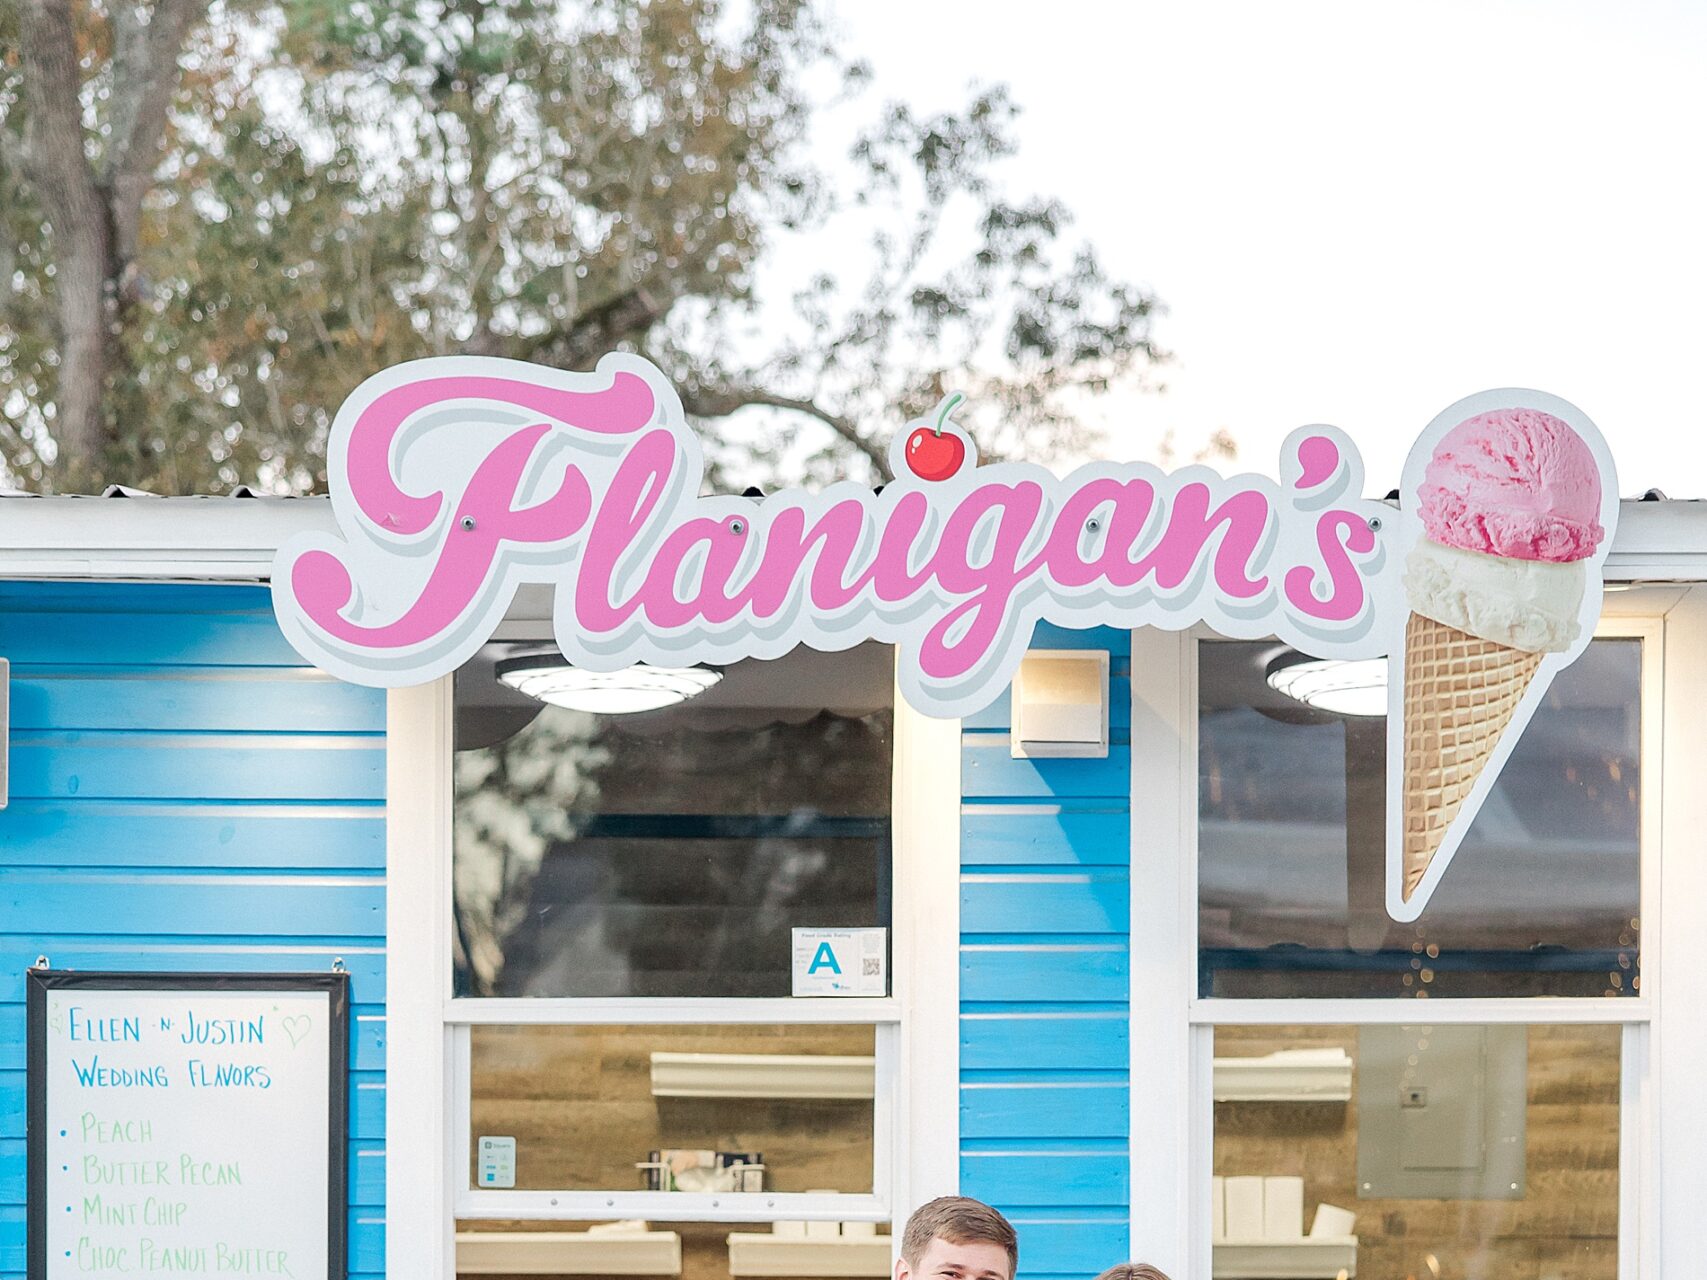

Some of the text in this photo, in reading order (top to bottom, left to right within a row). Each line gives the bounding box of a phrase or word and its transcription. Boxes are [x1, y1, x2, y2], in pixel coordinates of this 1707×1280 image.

[291, 371, 1374, 680] Flanigan's
[808, 941, 842, 975] A
[69, 1007, 140, 1042] ELLEN
[181, 1010, 264, 1045] JUSTIN
[72, 1055, 272, 1089] WEDDING FLAVORS
[81, 1112, 153, 1143] PEACH
[83, 1153, 242, 1185] BUTTER PECAN
[83, 1194, 187, 1227] MINT CHIP
[78, 1236, 295, 1279] CHOC PEANUT BUTTER
